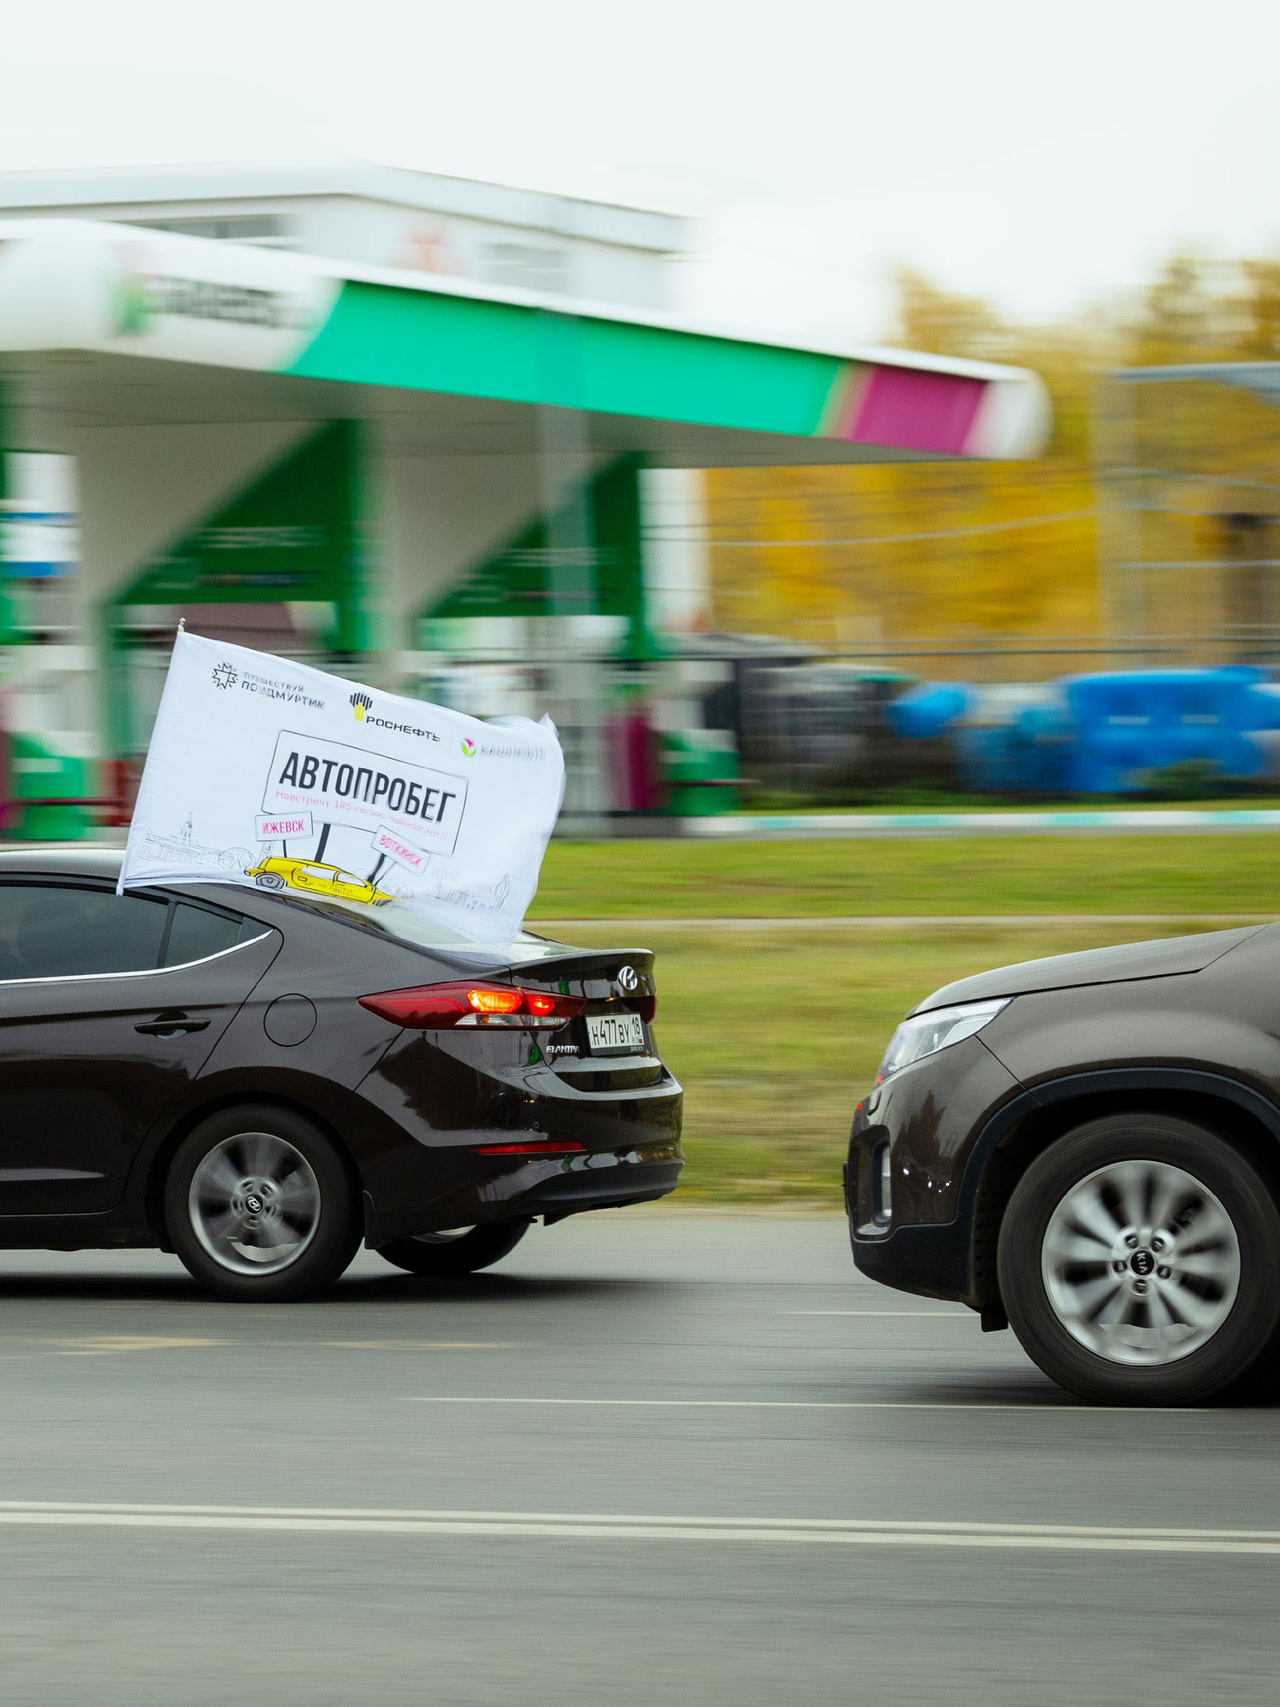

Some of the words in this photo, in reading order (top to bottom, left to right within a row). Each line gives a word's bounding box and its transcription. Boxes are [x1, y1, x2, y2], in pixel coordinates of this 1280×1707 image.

[365, 715, 441, 742] РОСНЕФТЬ
[278, 751, 457, 823] АВТОПРОБЕГ
[262, 820, 305, 835] ИЖЕВСК
[1136, 1252, 1149, 1274] KIA
